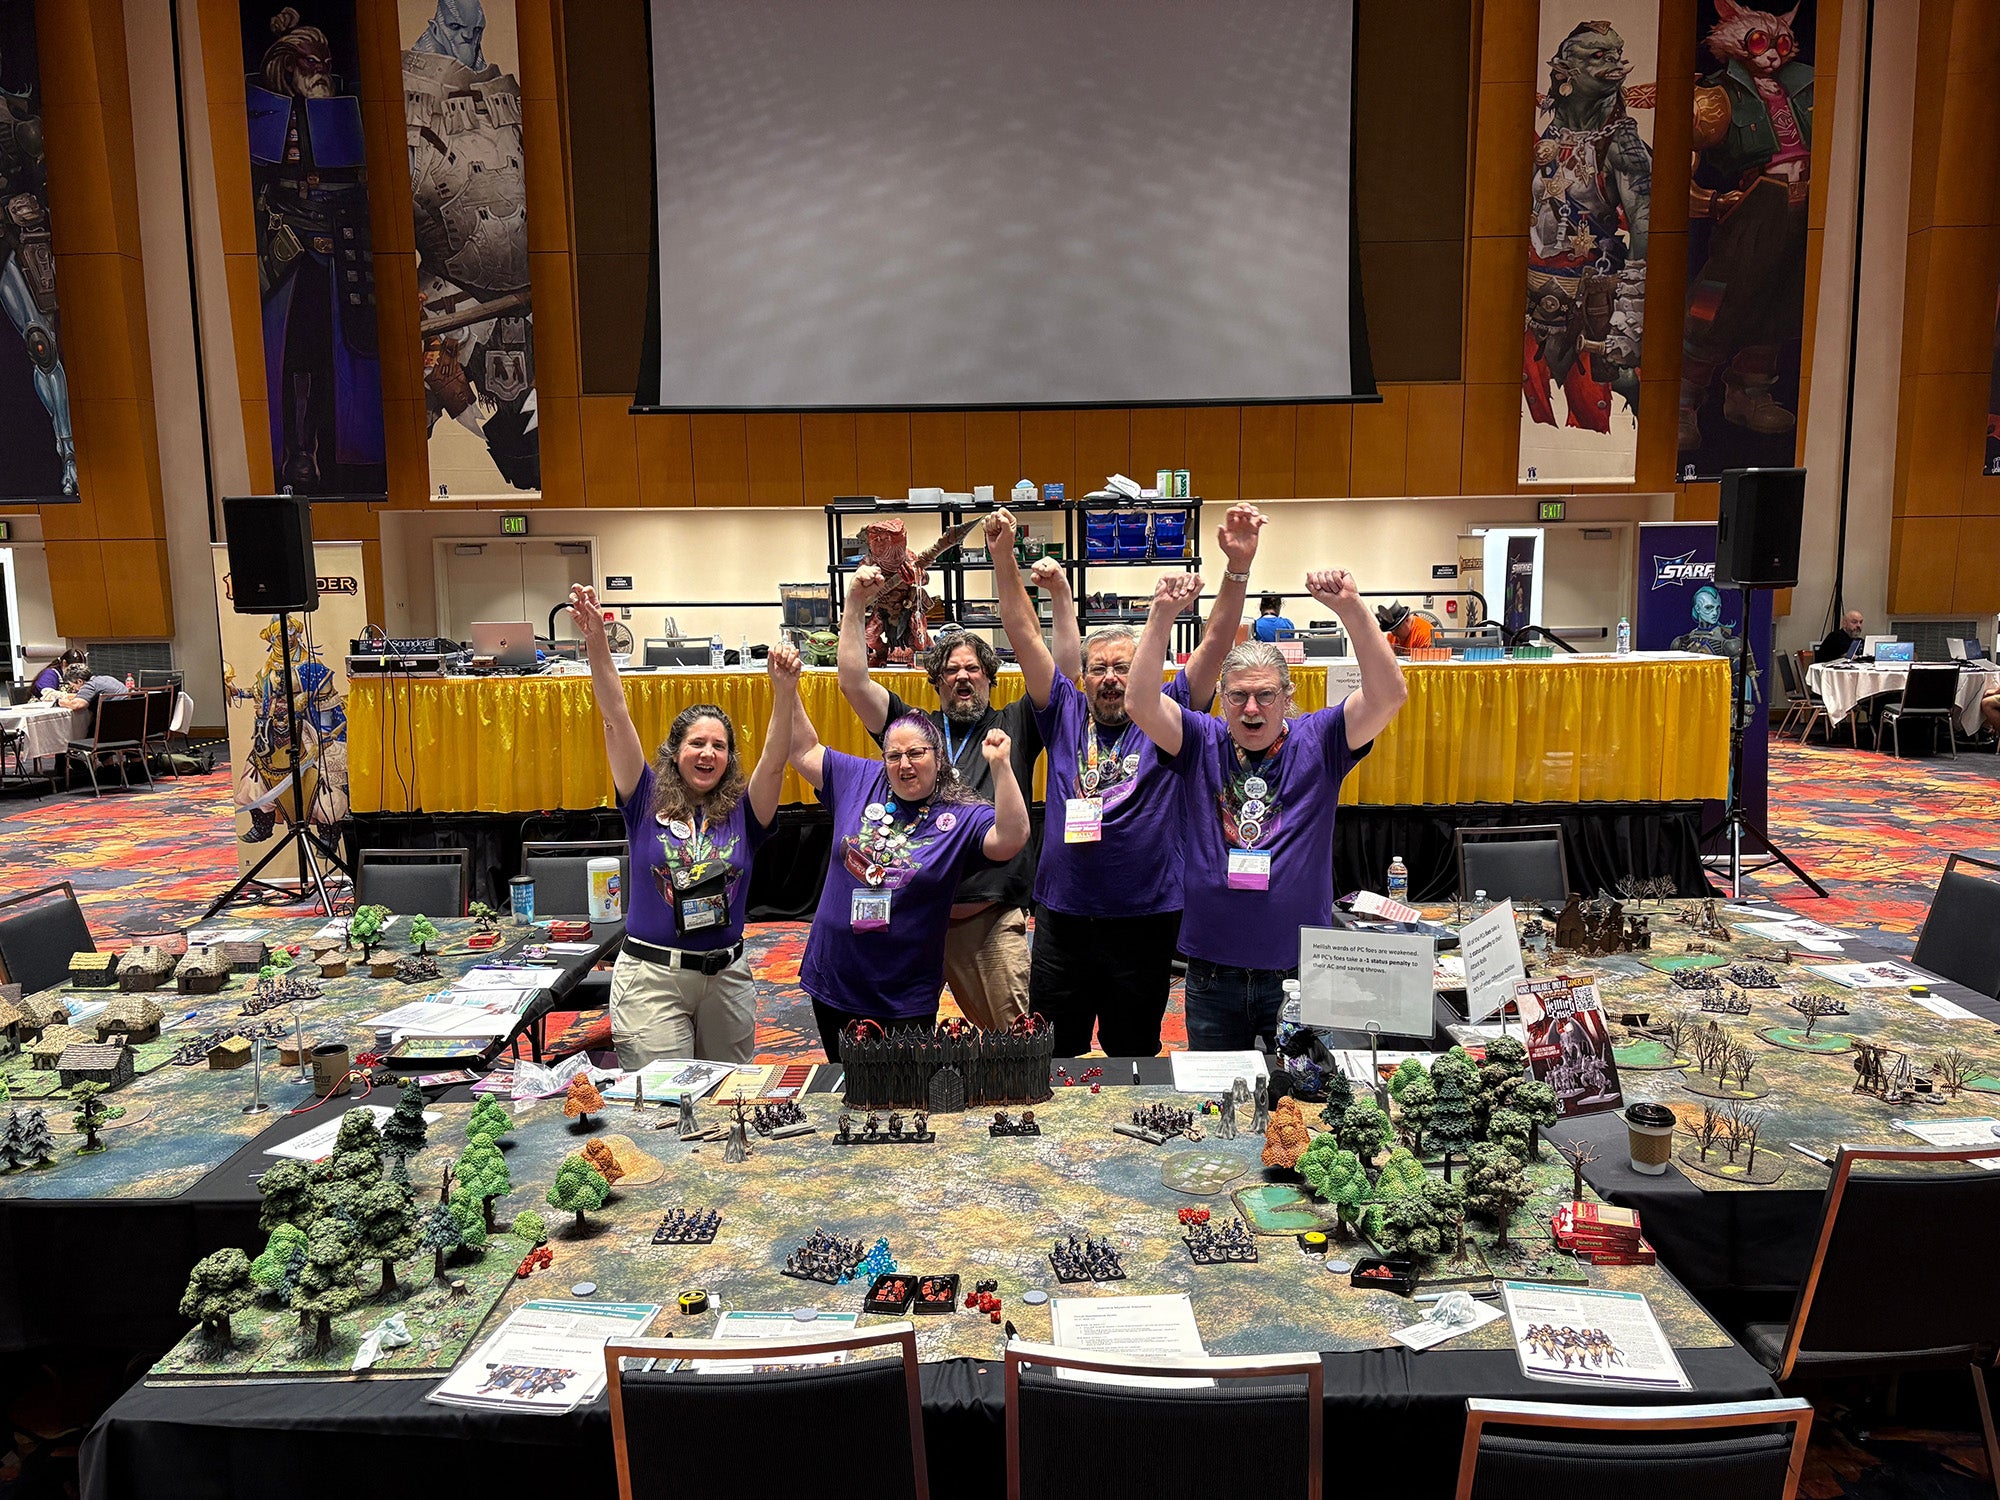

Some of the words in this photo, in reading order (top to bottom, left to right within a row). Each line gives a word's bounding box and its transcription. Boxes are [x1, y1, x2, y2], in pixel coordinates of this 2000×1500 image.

[1542, 503, 1562, 518] EXIT
[504, 518, 523, 532] EXIT
[1658, 564, 1716, 579] STARF
[1389, 949, 1419, 957] weakened.
[1481, 941, 1492, 952] penalty
[1365, 966, 1387, 974] throws.
[1531, 981, 1551, 993] AVAILABLE
[1552, 980, 1562, 991] ONLY
[1567, 979, 1583, 988] GAMERS
[1545, 998, 1575, 1015] Hellfire
